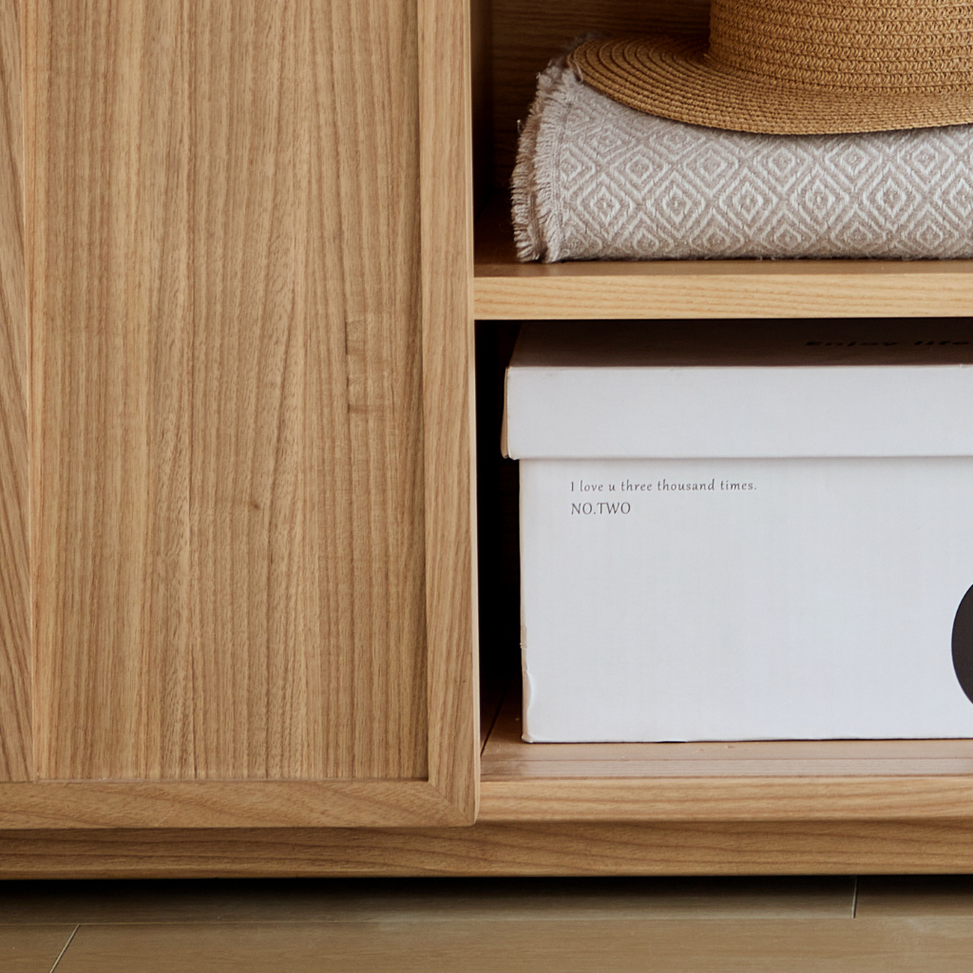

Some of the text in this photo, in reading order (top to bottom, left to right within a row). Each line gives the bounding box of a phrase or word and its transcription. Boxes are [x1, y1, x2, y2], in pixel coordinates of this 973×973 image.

[570, 478, 757, 492] I love u three thousand times.
[571, 502, 631, 515] NO.TWO
